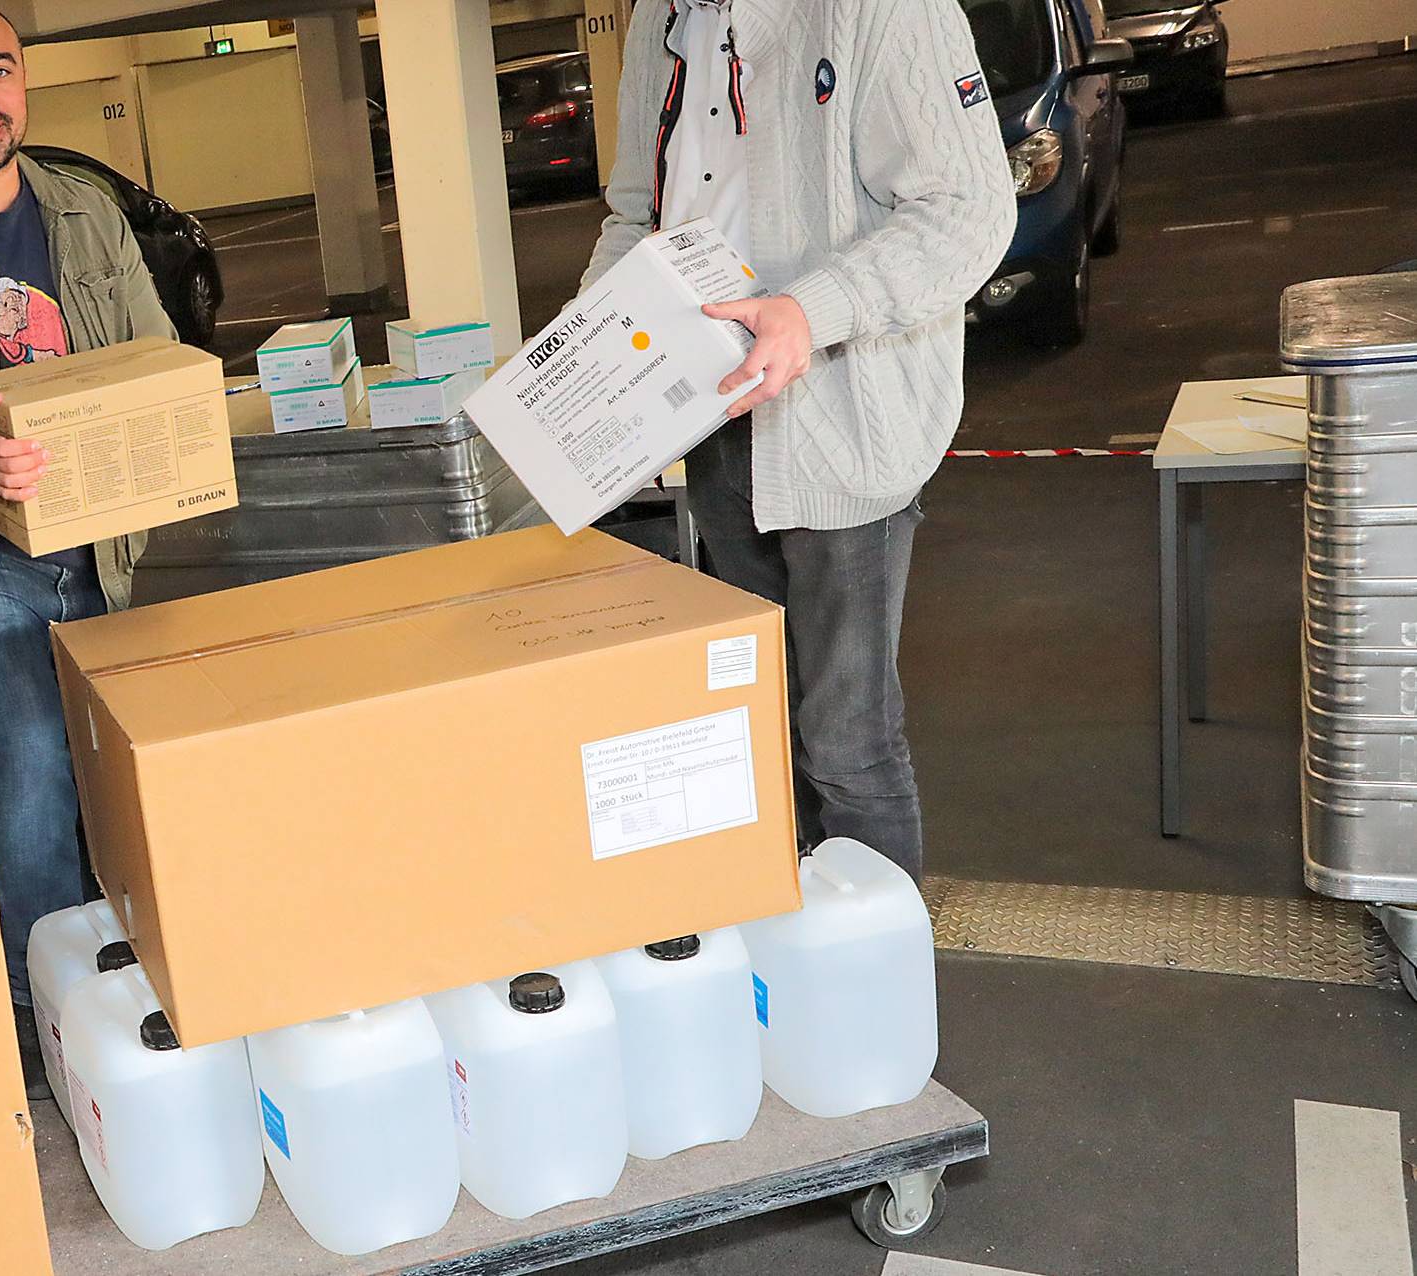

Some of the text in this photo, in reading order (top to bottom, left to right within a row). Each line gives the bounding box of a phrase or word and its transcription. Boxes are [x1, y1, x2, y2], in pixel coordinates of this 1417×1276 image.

[588, 14, 615, 34] 011
[103, 103, 125, 120] 012
[621, 316, 634, 330] M
[527, 312, 588, 369] HYGOSTAR
[517, 344, 583, 401] Nitril-Handschuh,
[582, 311, 618, 346] puderfrei
[524, 389, 547, 410] SAFE
[547, 359, 580, 391] TENDER
[607, 383, 630, 406] Art.-Nr.
[26, 403, 103, 429] Vasco® Nitril light
[187, 488, 227, 507] BRAUN
[620, 737, 661, 752] Automotive
[597, 773, 638, 790] 73000001
[595, 791, 644, 810] 1000 Stück
